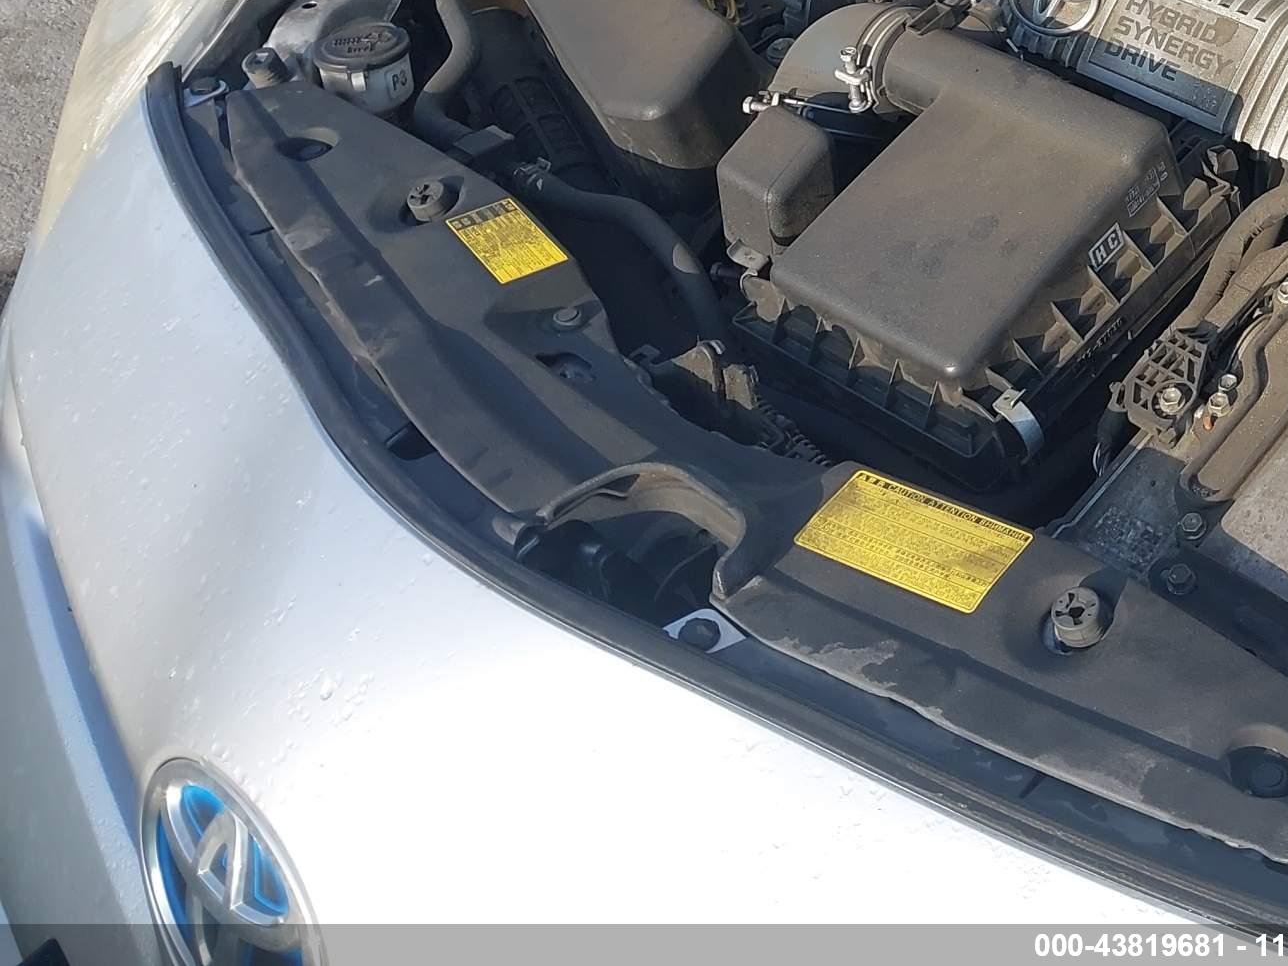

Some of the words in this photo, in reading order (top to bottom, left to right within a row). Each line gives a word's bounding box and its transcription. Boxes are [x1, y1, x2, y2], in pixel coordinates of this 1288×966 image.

[1104, 36, 1181, 82] DRIVE
[1113, 17, 1234, 78] SYNERGY
[887, 483, 925, 503] CAUTION
[928, 498, 977, 522] ATTENTION
